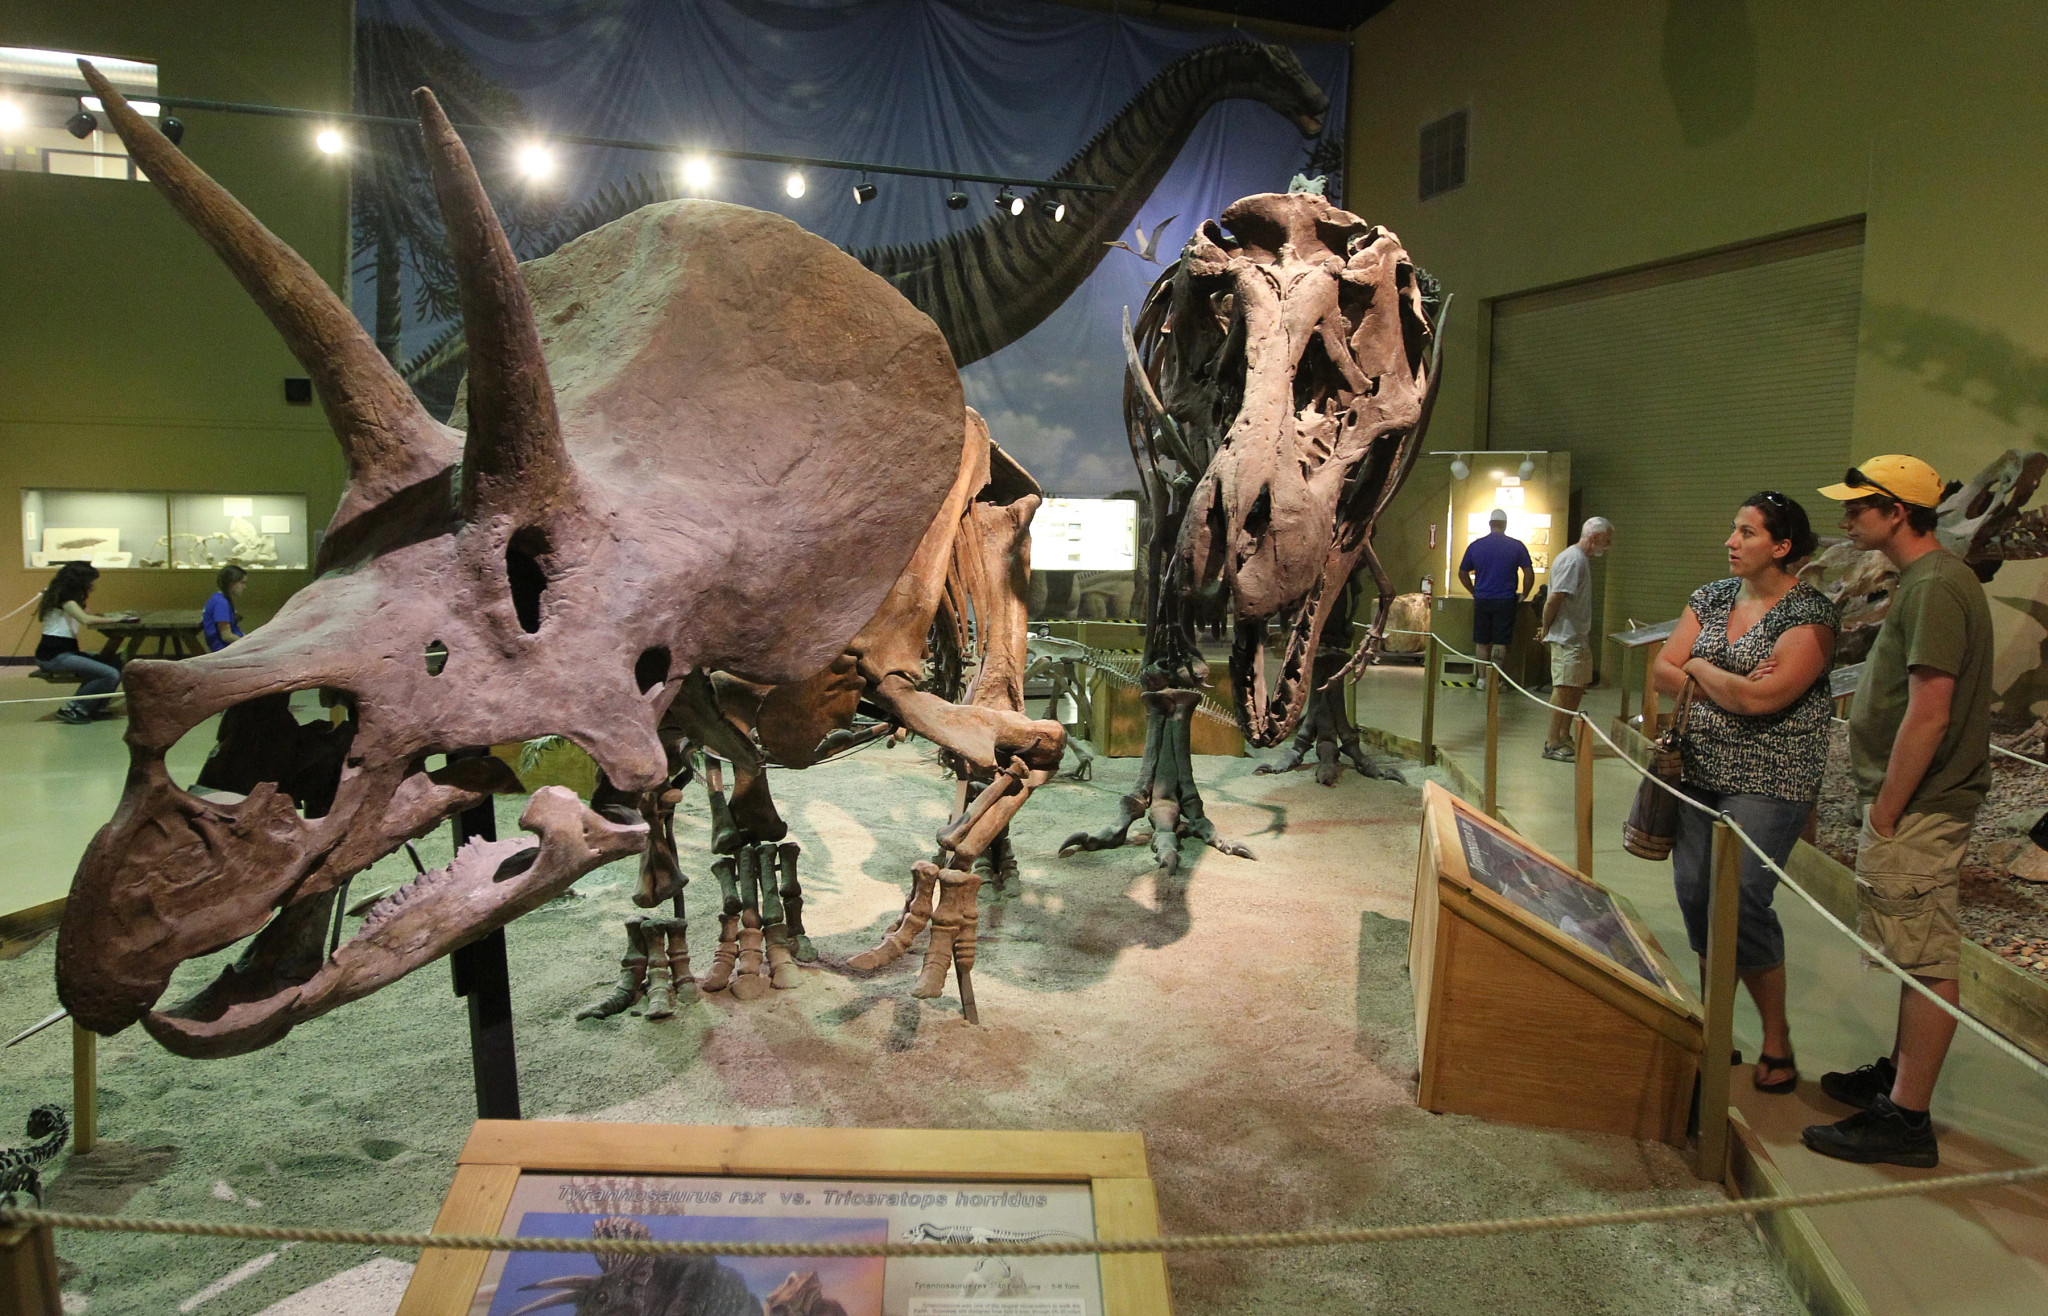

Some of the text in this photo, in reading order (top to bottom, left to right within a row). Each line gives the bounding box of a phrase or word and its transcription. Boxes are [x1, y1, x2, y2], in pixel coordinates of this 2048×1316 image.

[558, 1185, 1048, 1211] Tyrannosaurus rex vs. Triceratops horridus
